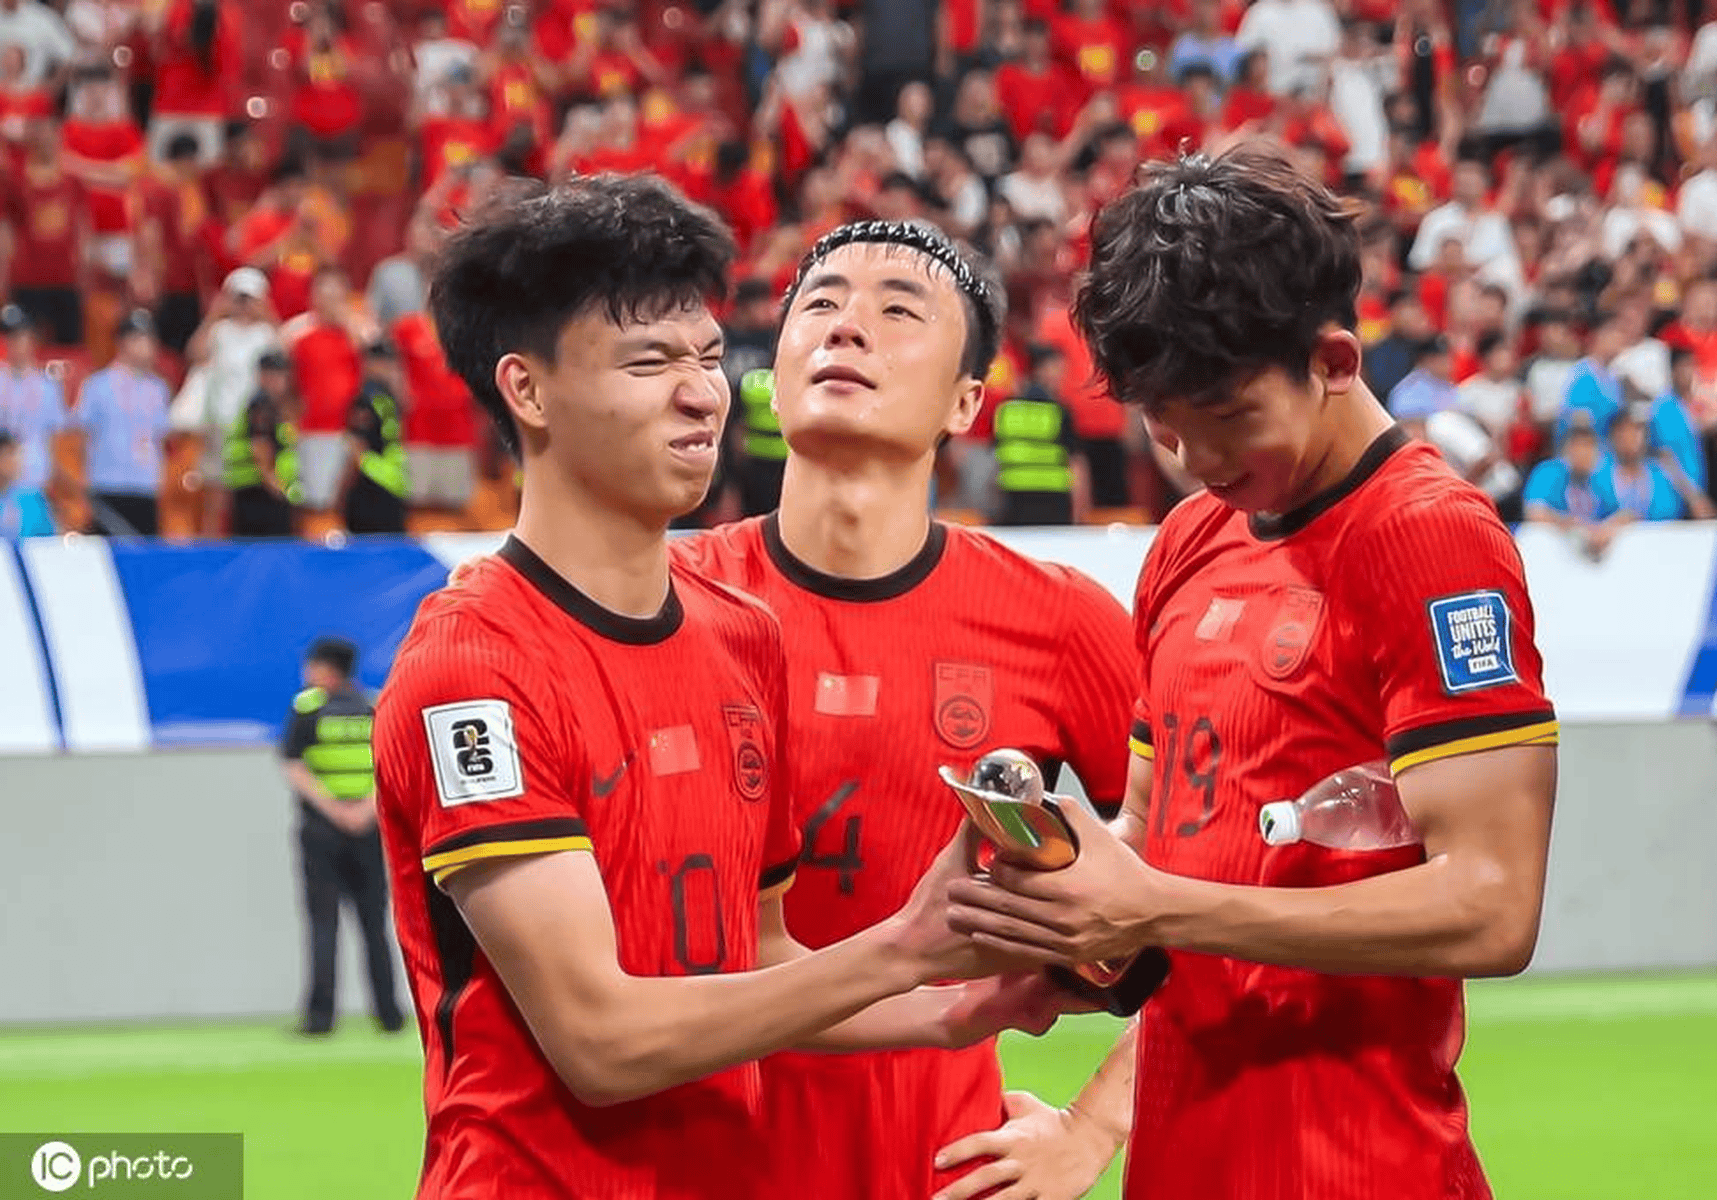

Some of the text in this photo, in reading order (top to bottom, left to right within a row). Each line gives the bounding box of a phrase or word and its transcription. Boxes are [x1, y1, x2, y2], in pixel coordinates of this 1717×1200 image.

[1450, 620, 1497, 642] UNITES
[1471, 658, 1496, 670] FIFA
[1154, 711, 1221, 837] 19
[800, 778, 863, 893] 4
[656, 854, 727, 976] 0
